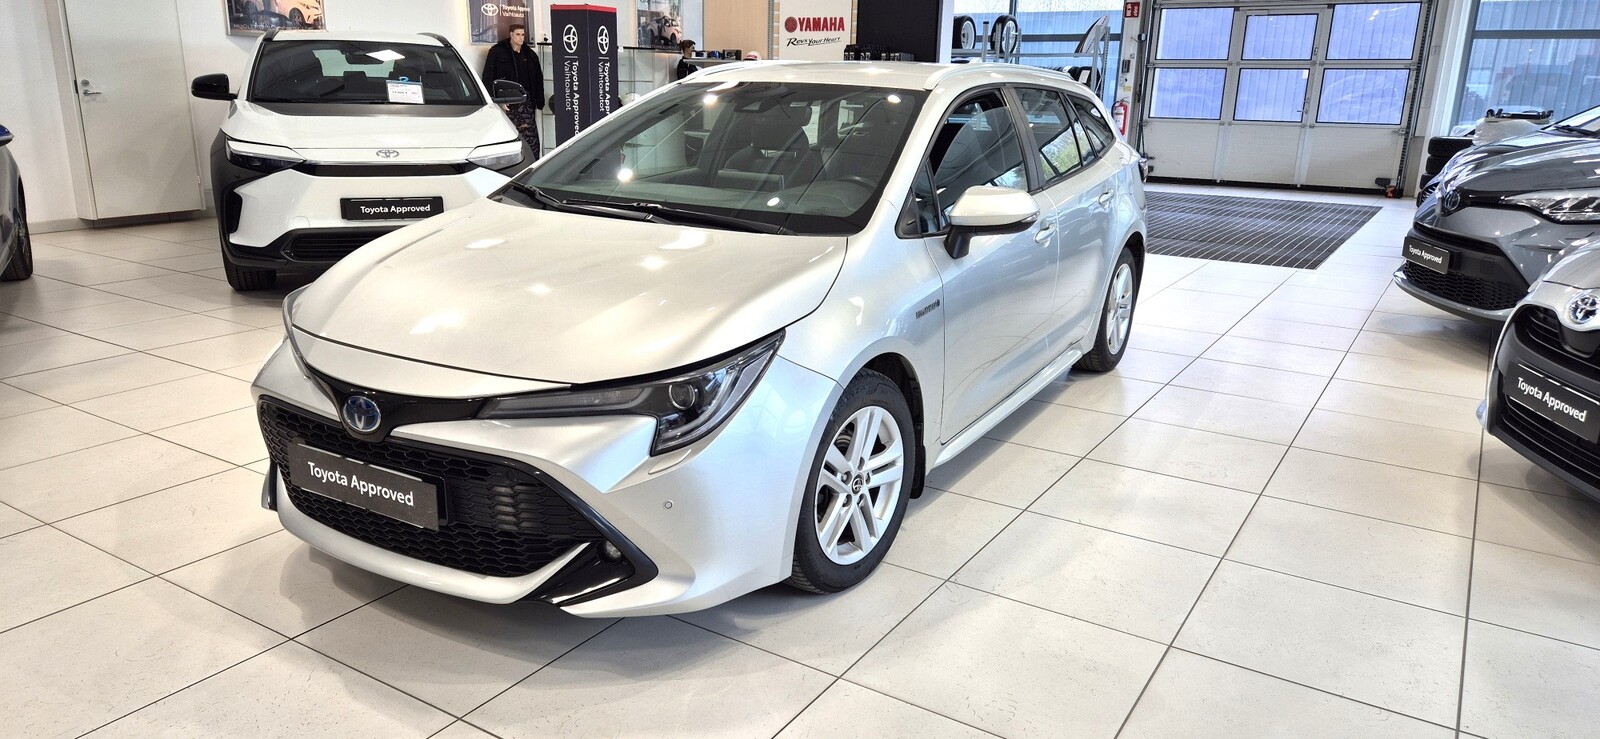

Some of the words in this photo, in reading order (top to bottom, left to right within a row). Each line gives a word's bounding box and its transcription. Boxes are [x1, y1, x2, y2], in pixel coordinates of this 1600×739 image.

[798, 17, 845, 31] YAMAHA
[360, 206, 388, 215] Toyota
[390, 204, 431, 214] Approved
[1409, 244, 1421, 256] Toyota
[1421, 250, 1443, 264] Approved
[1518, 377, 1542, 400] Toyota
[1542, 391, 1587, 422] Approved
[307, 461, 348, 486] Toyota
[351, 475, 414, 507] Approved
